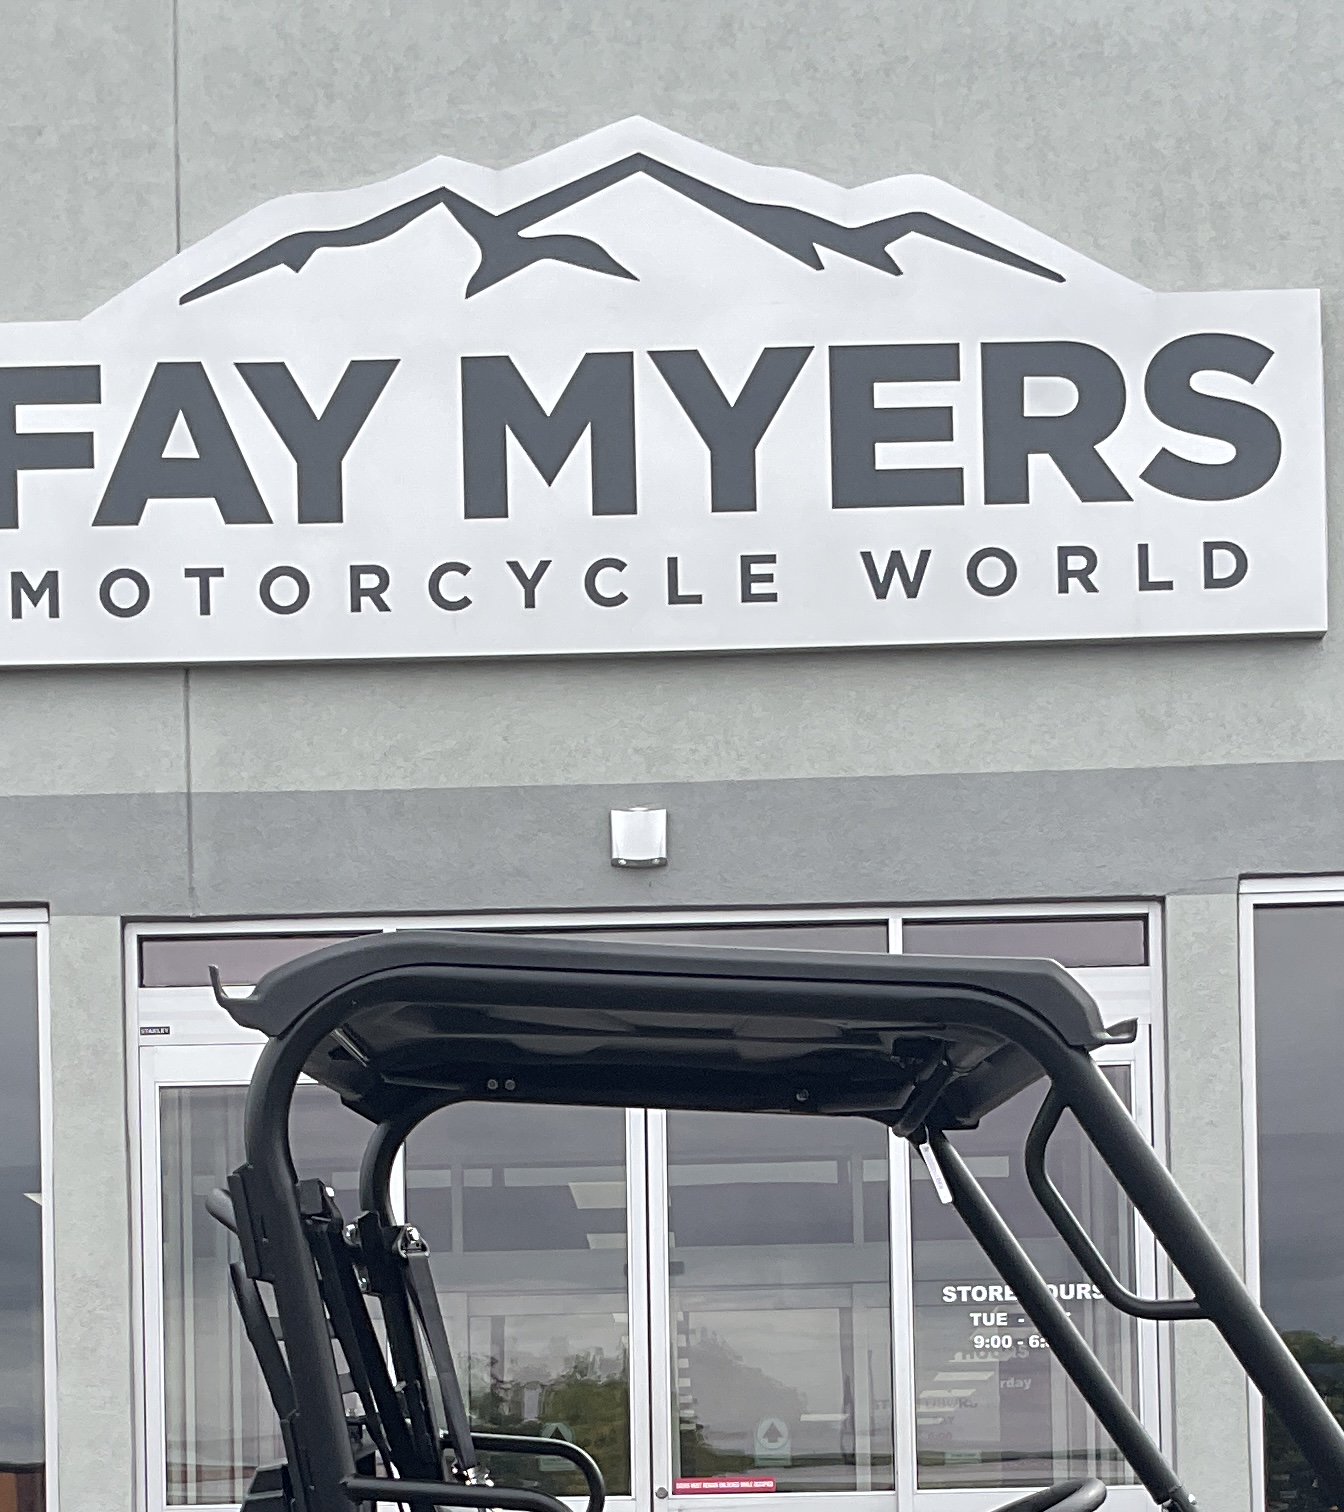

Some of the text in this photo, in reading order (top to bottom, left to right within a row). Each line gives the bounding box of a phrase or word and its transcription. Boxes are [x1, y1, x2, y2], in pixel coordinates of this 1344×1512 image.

[461, 333, 1281, 519] MYERS
[11, 541, 1248, 619] MOTORCYCLE WORLD
[942, 1284, 1104, 1302] STORE OURS
[969, 1312, 1008, 1326] TUE
[974, 1335, 1012, 1348] 9:00
